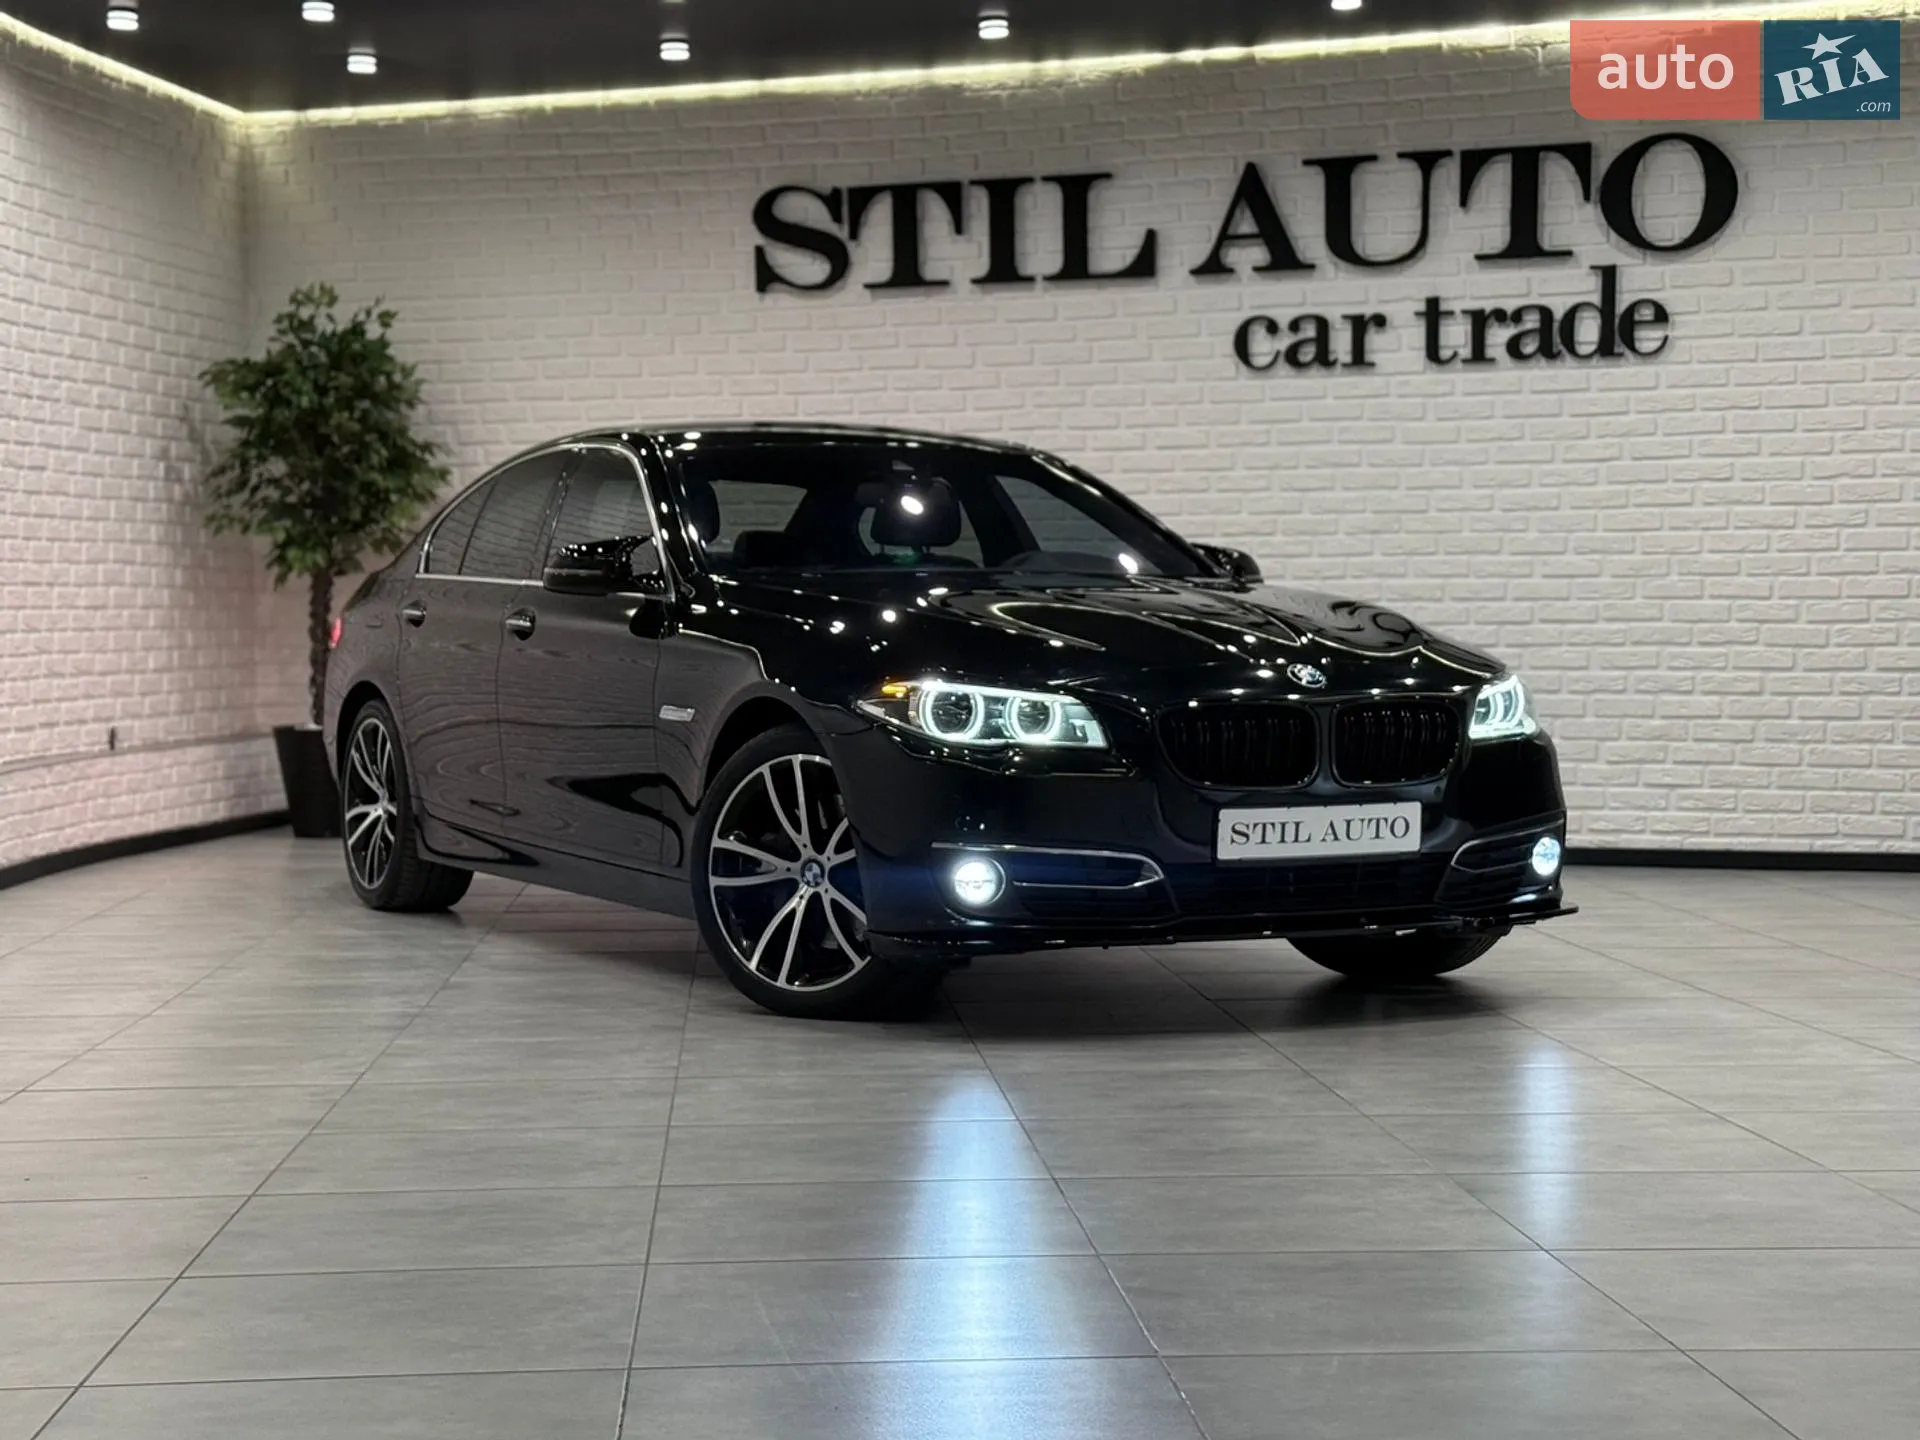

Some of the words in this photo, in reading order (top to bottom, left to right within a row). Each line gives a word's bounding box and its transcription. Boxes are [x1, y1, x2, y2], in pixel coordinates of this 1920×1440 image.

[752, 171, 1158, 295] STIL
[1189, 131, 1740, 276] AUTO
[1234, 313, 1388, 370] car
[1415, 264, 1670, 365] trade
[1229, 820, 1312, 846] STIL
[1319, 815, 1411, 843] AUTO
